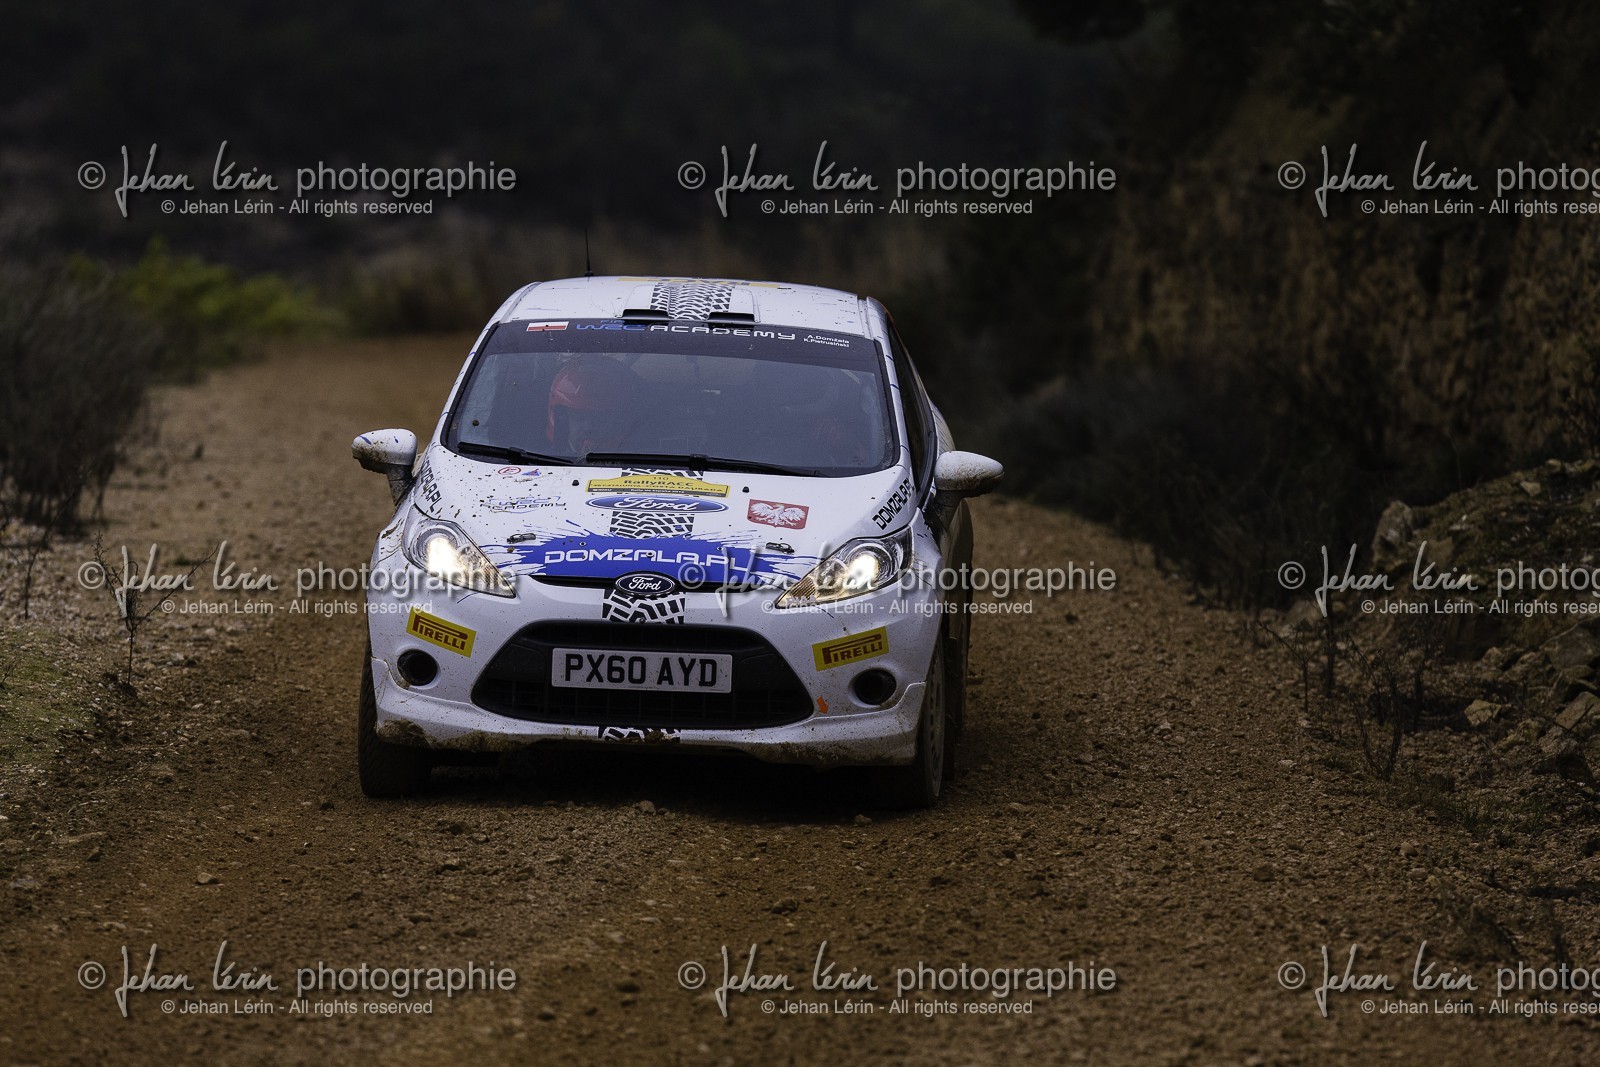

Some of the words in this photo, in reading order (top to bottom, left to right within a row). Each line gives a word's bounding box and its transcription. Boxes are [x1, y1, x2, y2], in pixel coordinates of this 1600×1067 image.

[651, 324, 796, 340] ACADEMY
[614, 496, 699, 511] Ford
[629, 577, 661, 591] Ford
[412, 613, 468, 651] PIRELLI
[822, 633, 883, 665] PIRELLI
[565, 653, 647, 685] PX60
[657, 657, 717, 686] AYD
